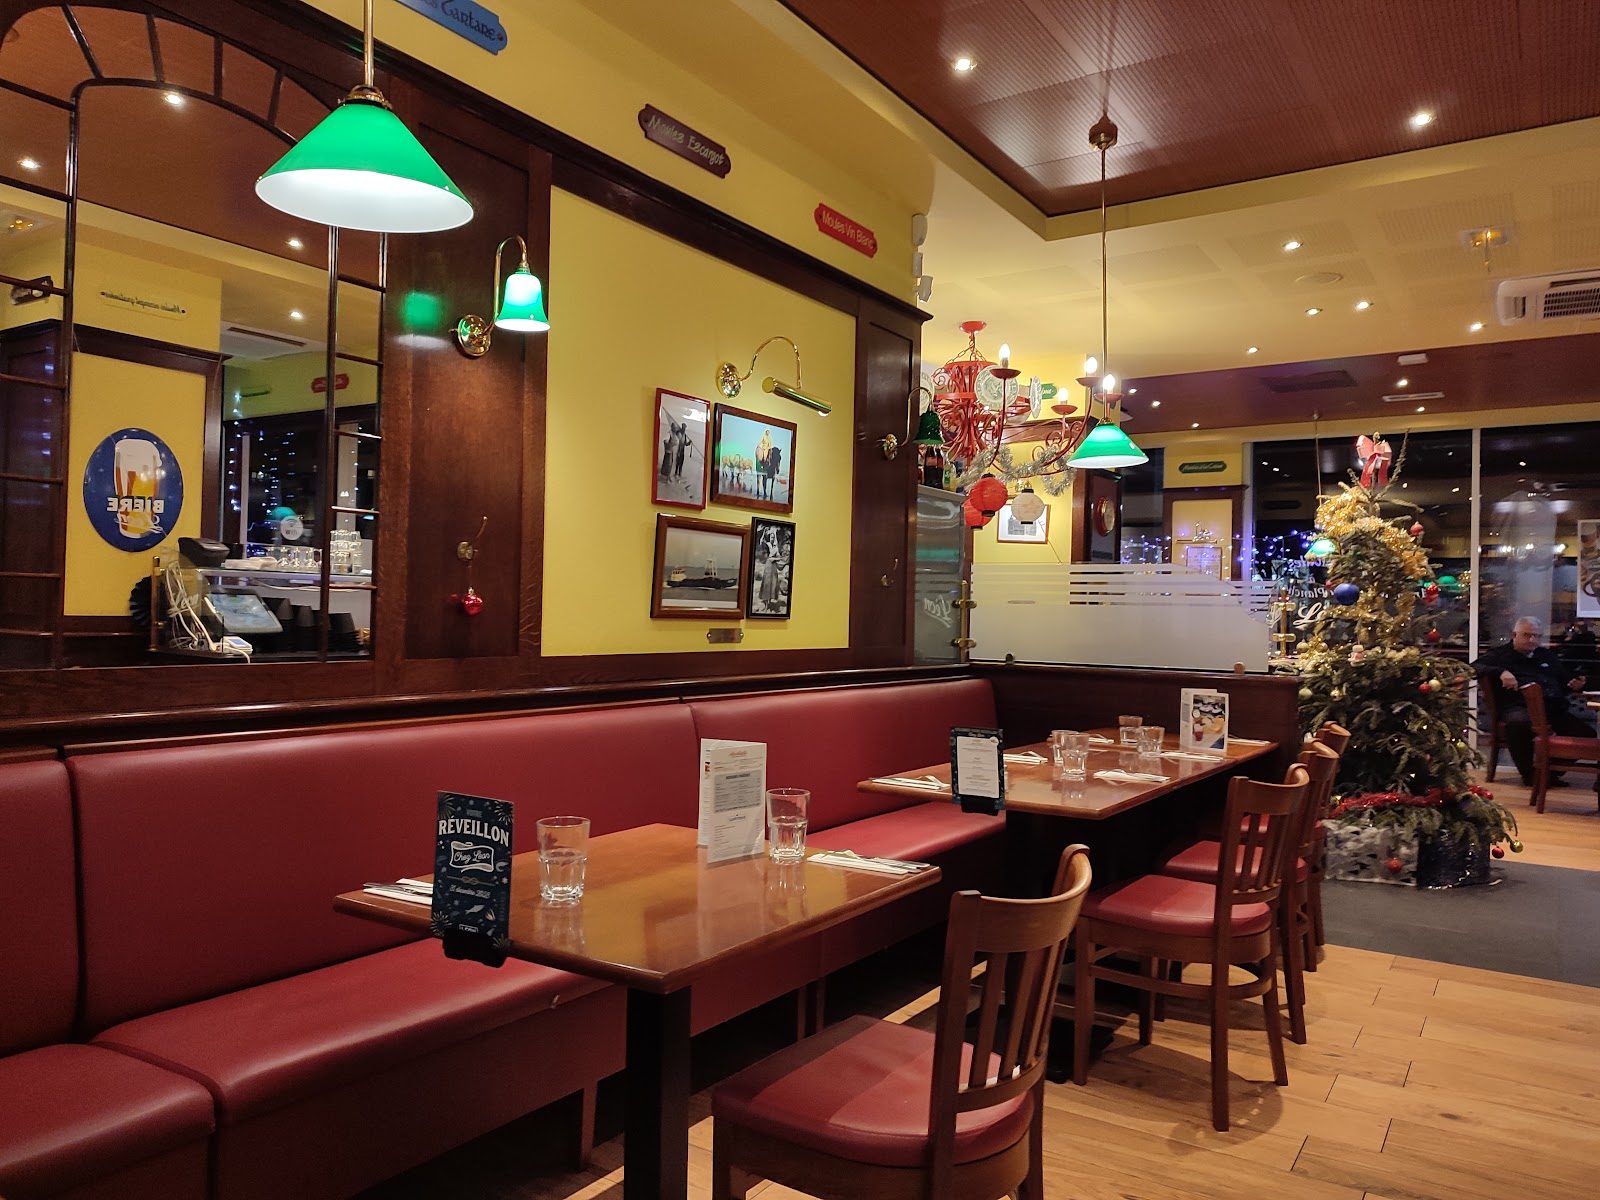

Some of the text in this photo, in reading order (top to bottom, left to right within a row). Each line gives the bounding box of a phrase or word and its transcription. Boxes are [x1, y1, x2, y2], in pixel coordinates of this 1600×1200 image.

[687, 136, 725, 166] Escargot
[822, 210, 846, 234] Moules
[438, 815, 510, 848] RÉVEILLON
